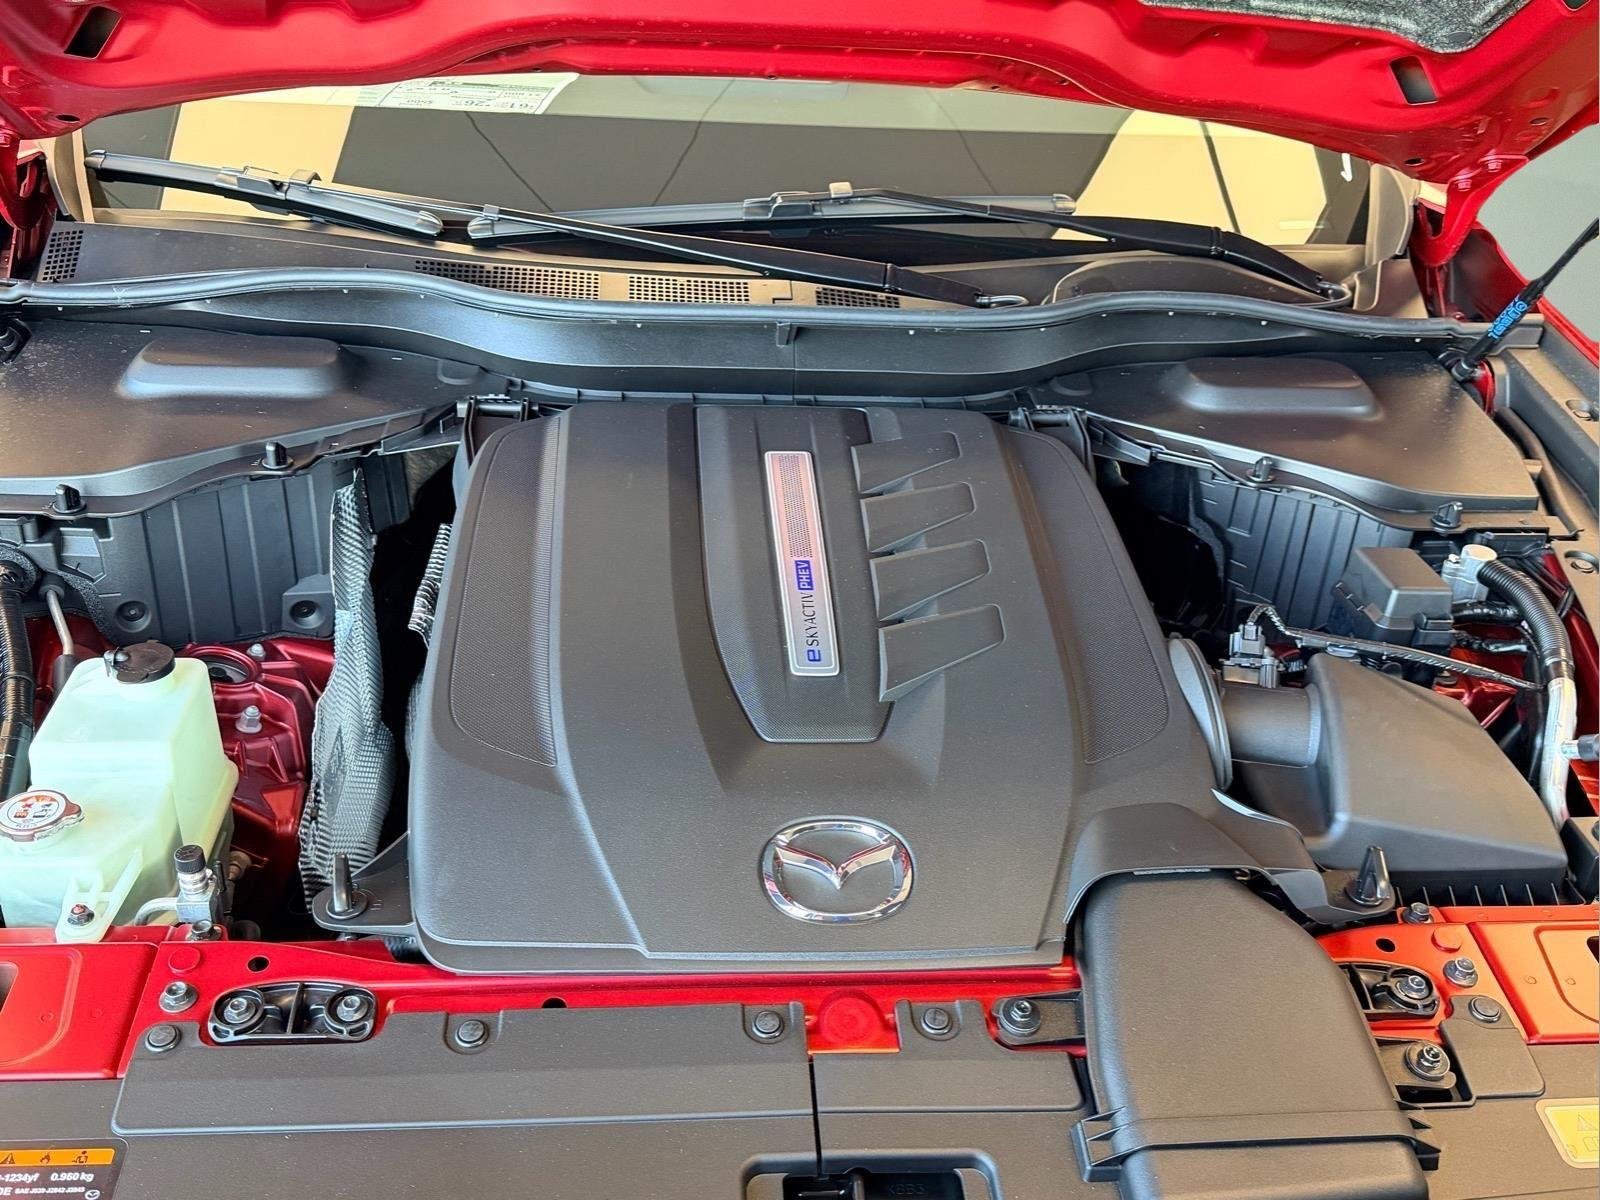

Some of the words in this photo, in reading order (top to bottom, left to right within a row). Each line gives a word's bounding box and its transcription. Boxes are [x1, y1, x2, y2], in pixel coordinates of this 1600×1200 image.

[797, 560, 812, 589] PHEV
[800, 592, 820, 647] SKYACTIV
[0, 1172, 40, 1184] -1234yf
[80, 1171, 94, 1183] kg
